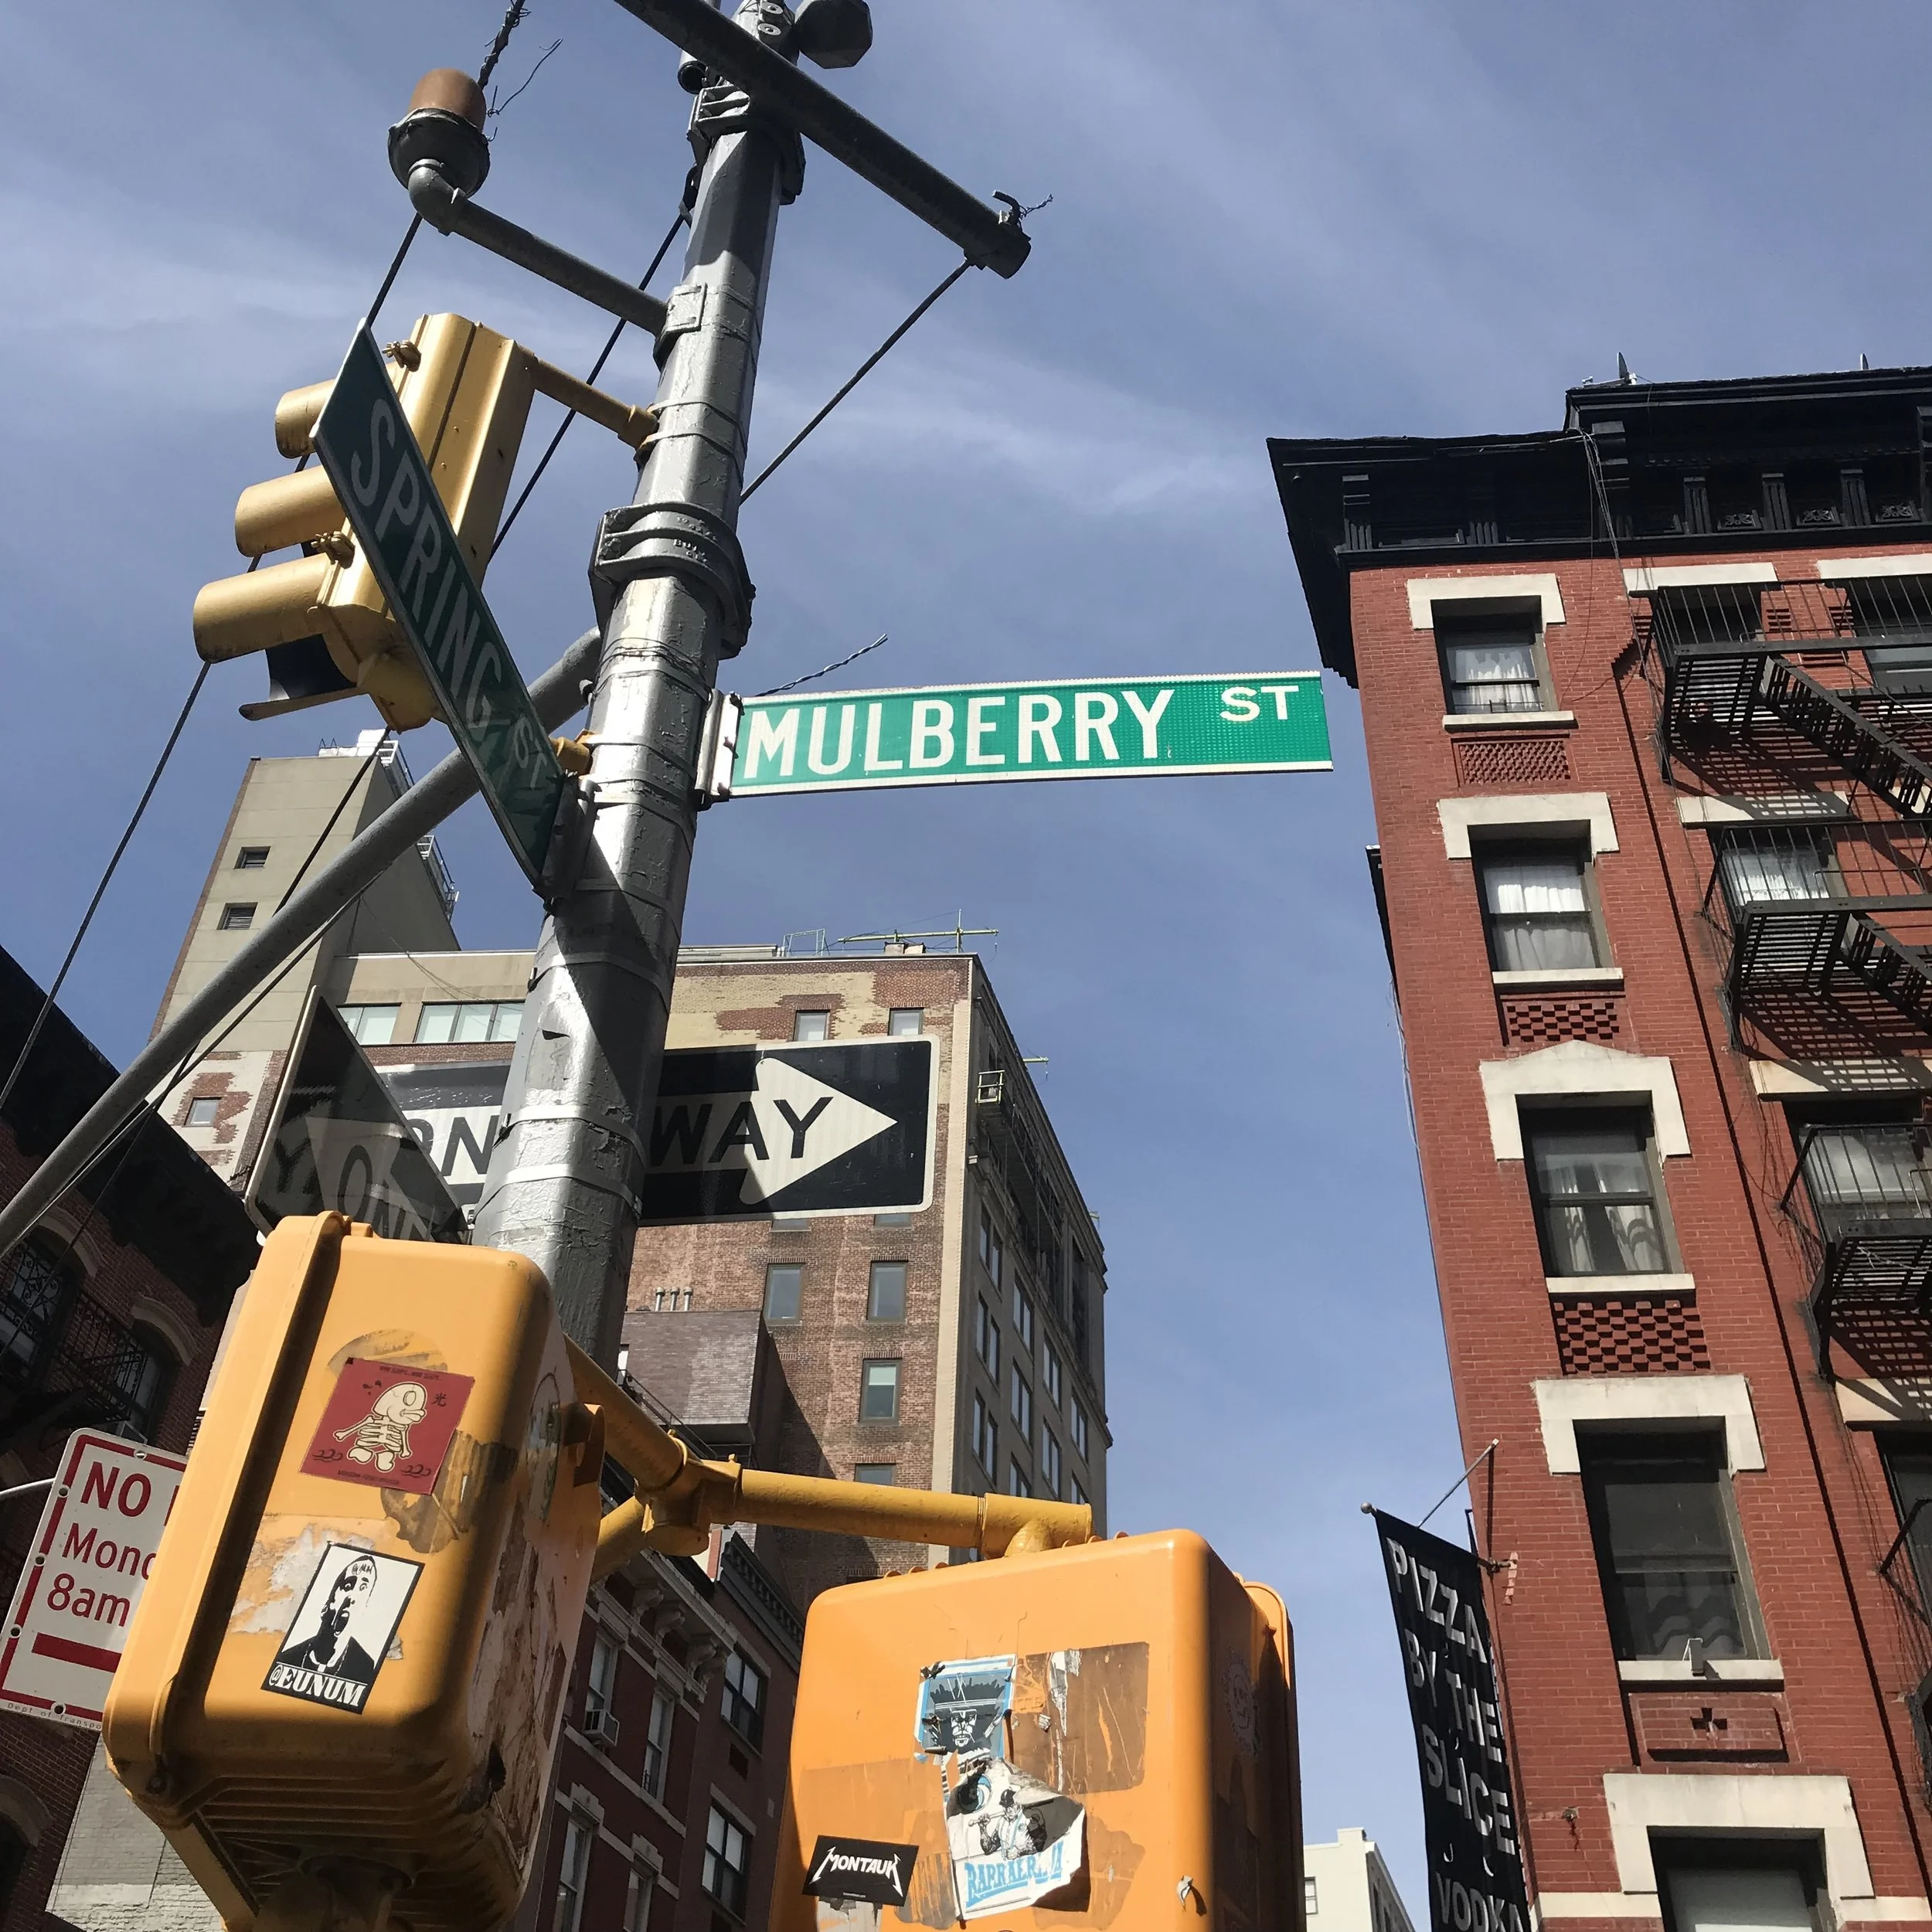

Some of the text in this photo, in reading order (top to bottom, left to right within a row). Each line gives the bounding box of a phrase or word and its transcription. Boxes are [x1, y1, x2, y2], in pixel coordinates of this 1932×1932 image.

[350, 398, 548, 790] SPRING ST
[743, 685, 1301, 780] MULBERRY ST
[649, 1097, 834, 1167] WAY
[80, 1461, 152, 1518] NO
[47, 1573, 131, 1628] 8am
[1386, 1536, 1488, 1664] PIZZA
[7, 1702, 32, 1713] Dept
[267, 1663, 368, 1709] @EUNUM
[1404, 1628, 1502, 1764] BY THE
[1422, 1724, 1516, 1855] SLICE
[808, 1846, 903, 1898] MONTAUK
